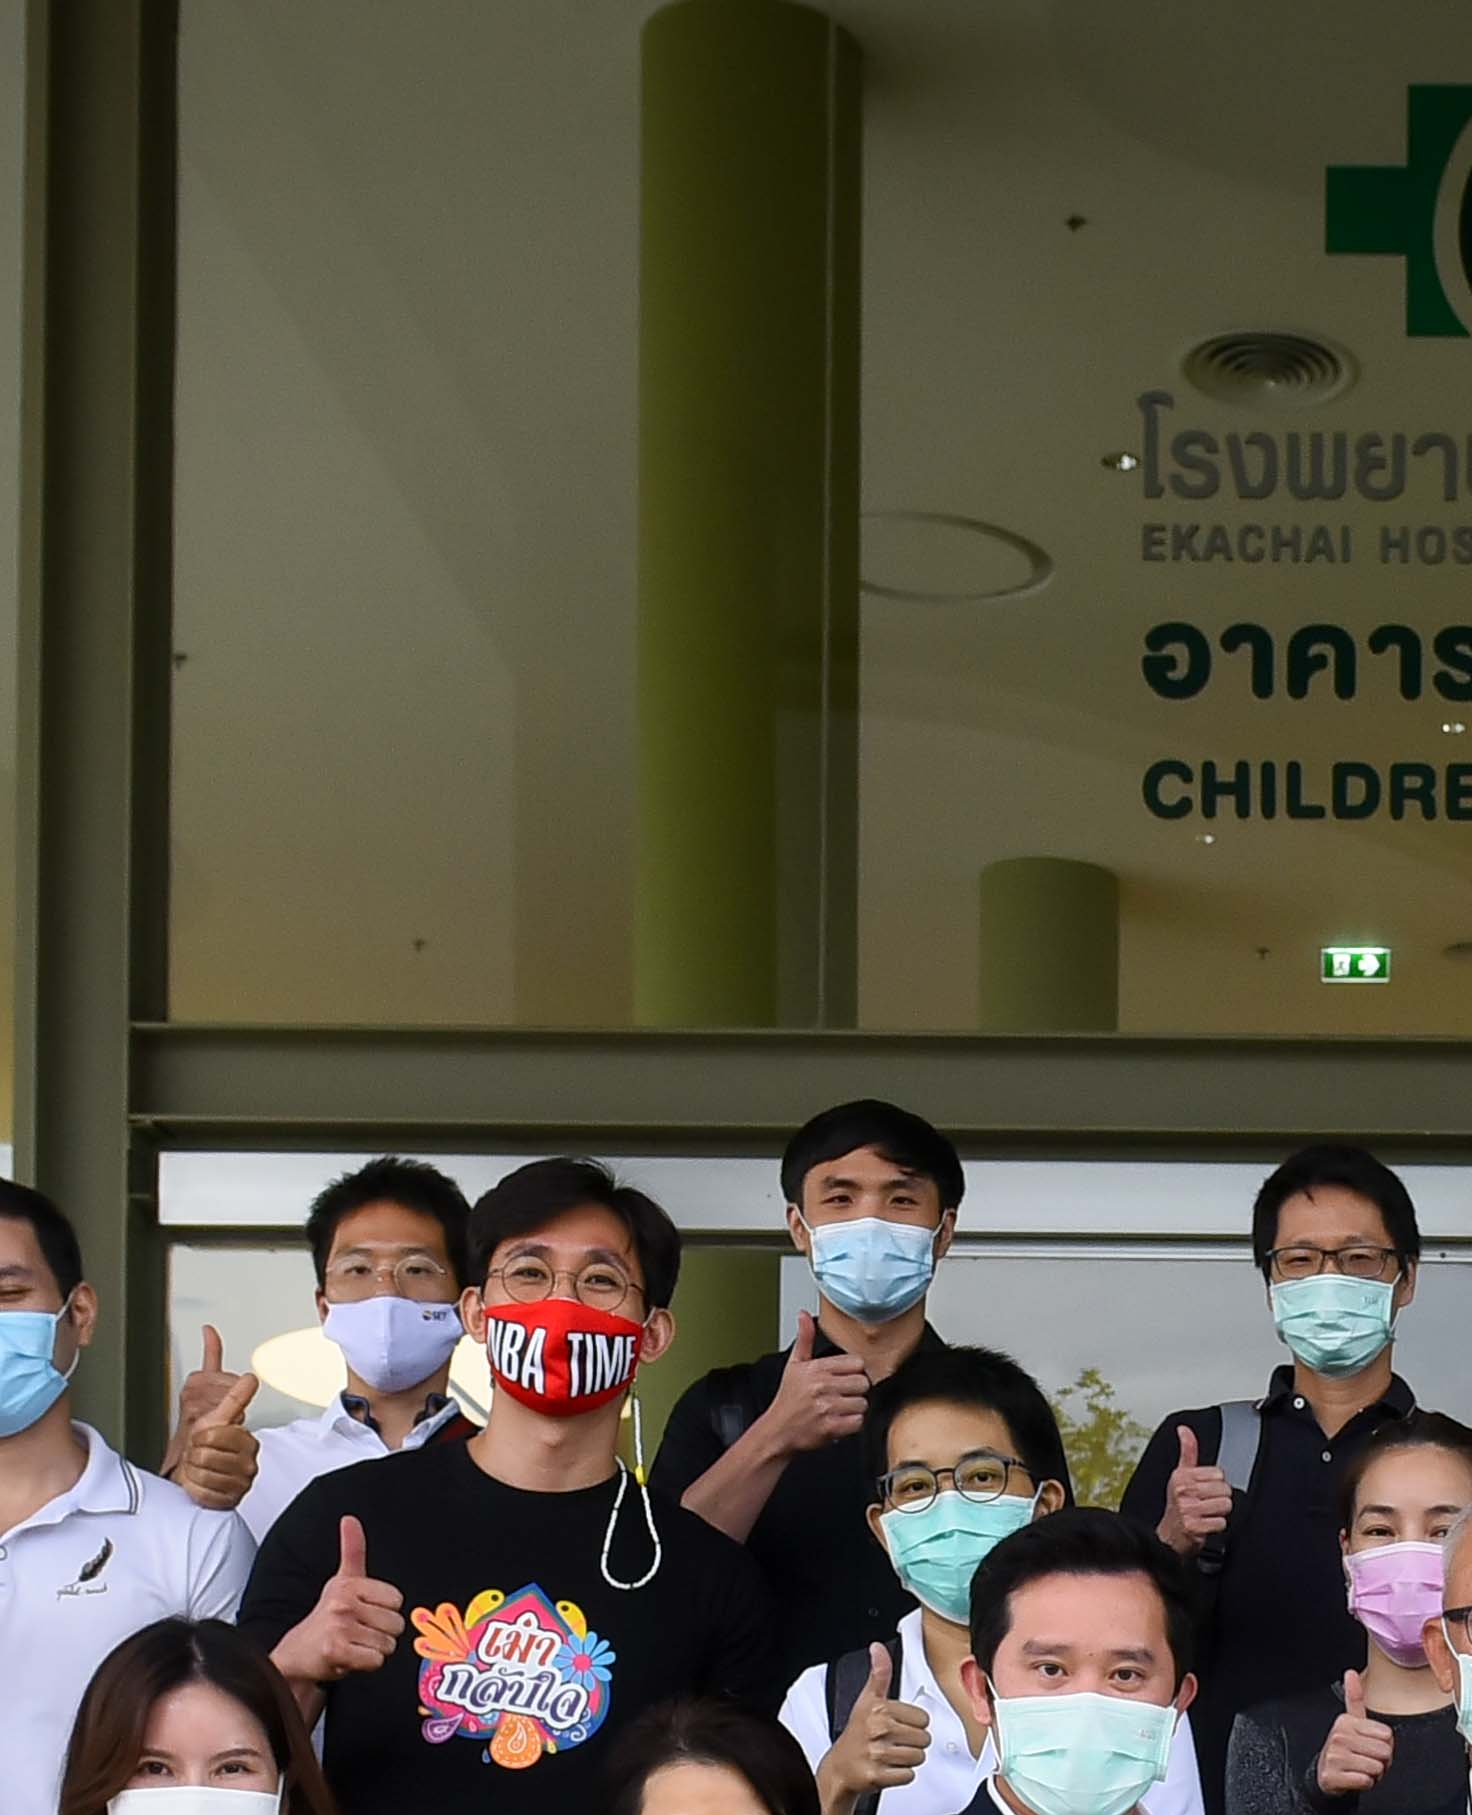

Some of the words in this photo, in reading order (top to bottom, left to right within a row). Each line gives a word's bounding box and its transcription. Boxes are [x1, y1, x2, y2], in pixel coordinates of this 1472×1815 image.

[1141, 523, 1352, 564] EKACHAI
[487, 1316, 547, 1395] NBA
[567, 1332, 637, 1398] TIME
[443, 1666, 583, 1723] กลับใจ
